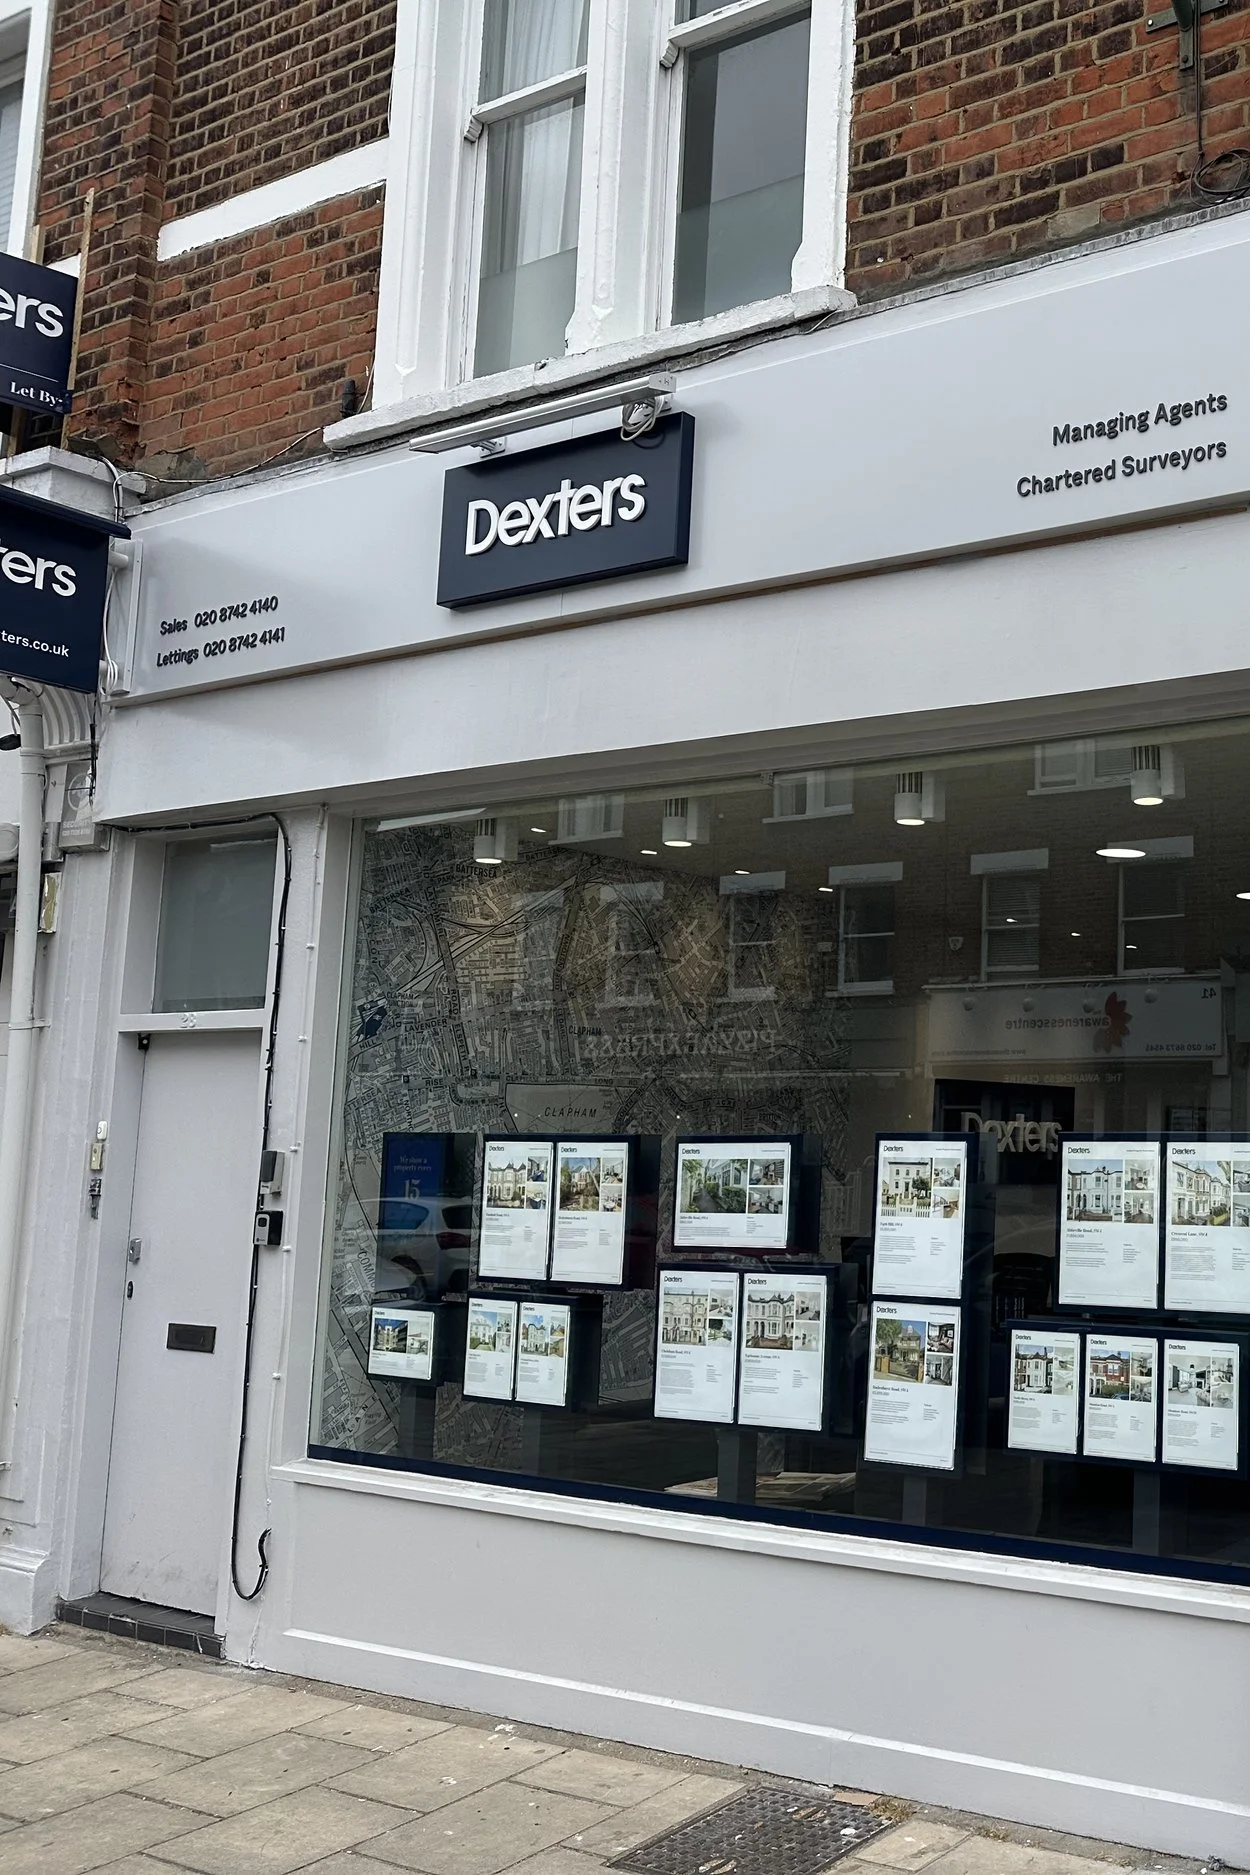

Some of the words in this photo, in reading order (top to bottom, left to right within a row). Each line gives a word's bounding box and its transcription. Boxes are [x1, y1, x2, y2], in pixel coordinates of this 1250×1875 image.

[10, 381, 35, 399] Let
[1052, 410, 1150, 446] Managing
[1154, 393, 1228, 426] Agents
[1017, 459, 1116, 497] Chartered
[1121, 441, 1227, 477] Surveyors
[465, 474, 646, 556] Dexters
[0, 538, 77, 597] ers
[160, 618, 188, 635] Sales
[194, 609, 217, 628] 020
[219, 602, 248, 622] 8742
[249, 596, 278, 615] 4140
[156, 647, 199, 667] Lettings
[203, 639, 227, 657] 020
[228, 632, 258, 652] 8742
[259, 626, 285, 645] 4141
[456, 864, 498, 879] BATTERSEA
[544, 1106, 597, 1118] CLAPHAM
